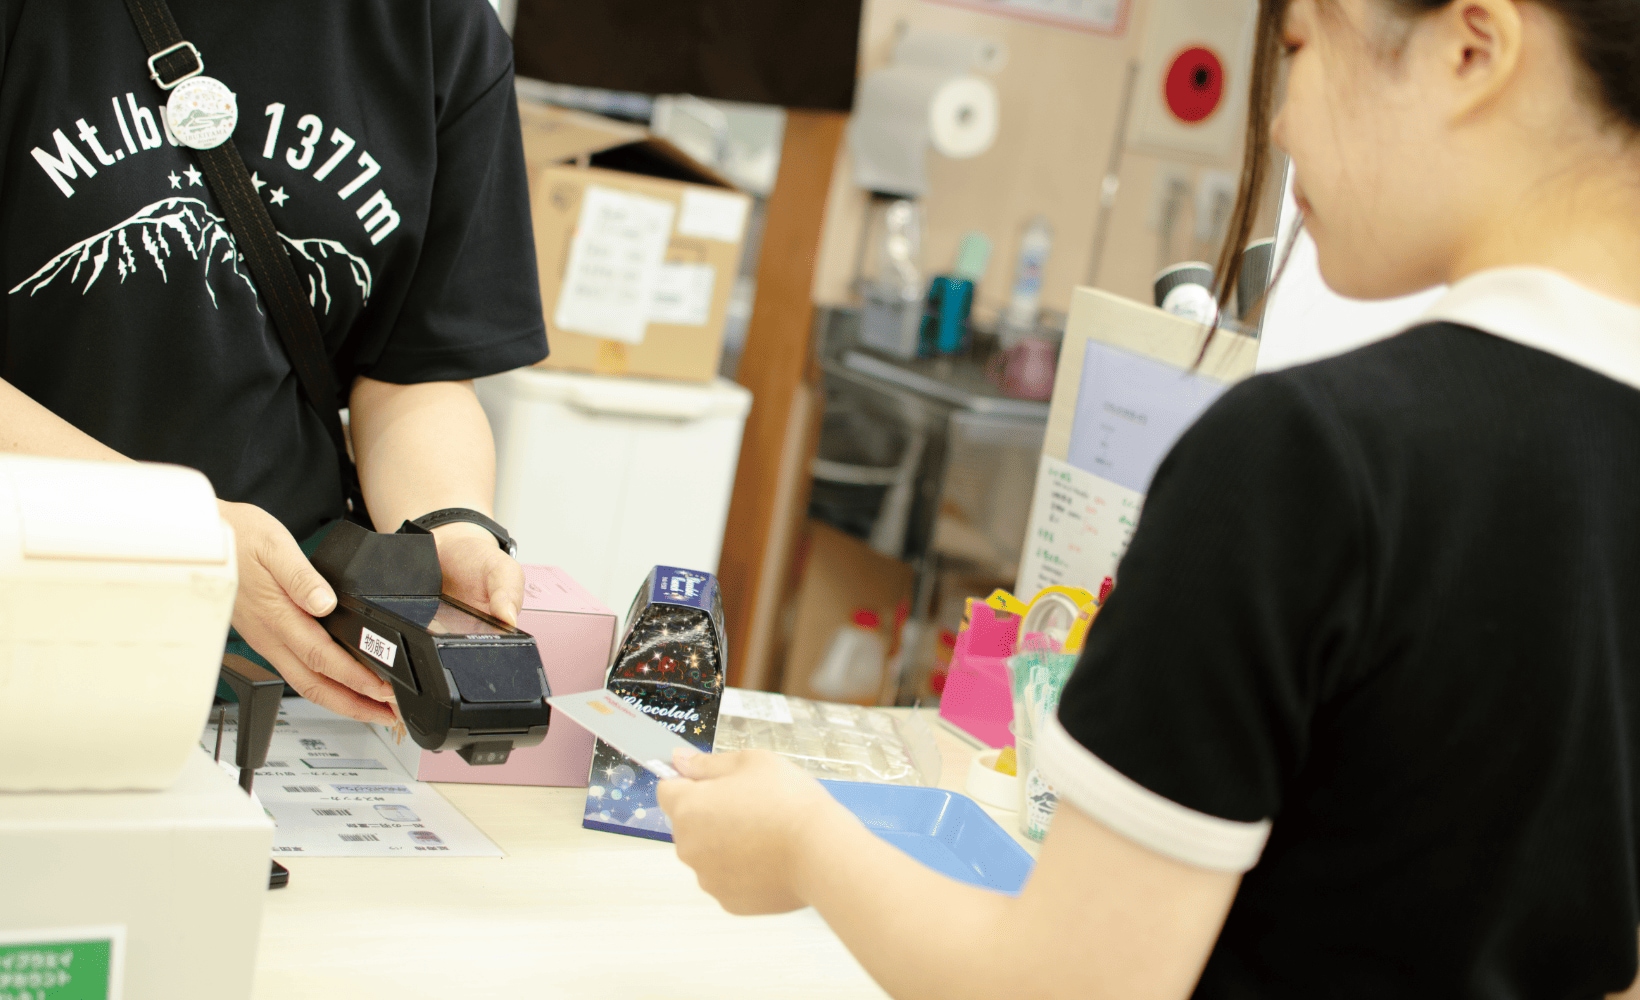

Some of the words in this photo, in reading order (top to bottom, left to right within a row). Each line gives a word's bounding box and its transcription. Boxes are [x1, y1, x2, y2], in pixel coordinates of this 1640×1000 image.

[30, 92, 236, 198] Mt.Ibu
[185, 129, 227, 141] IBUKIYAMA
[623, 696, 700, 721] Chocolate
